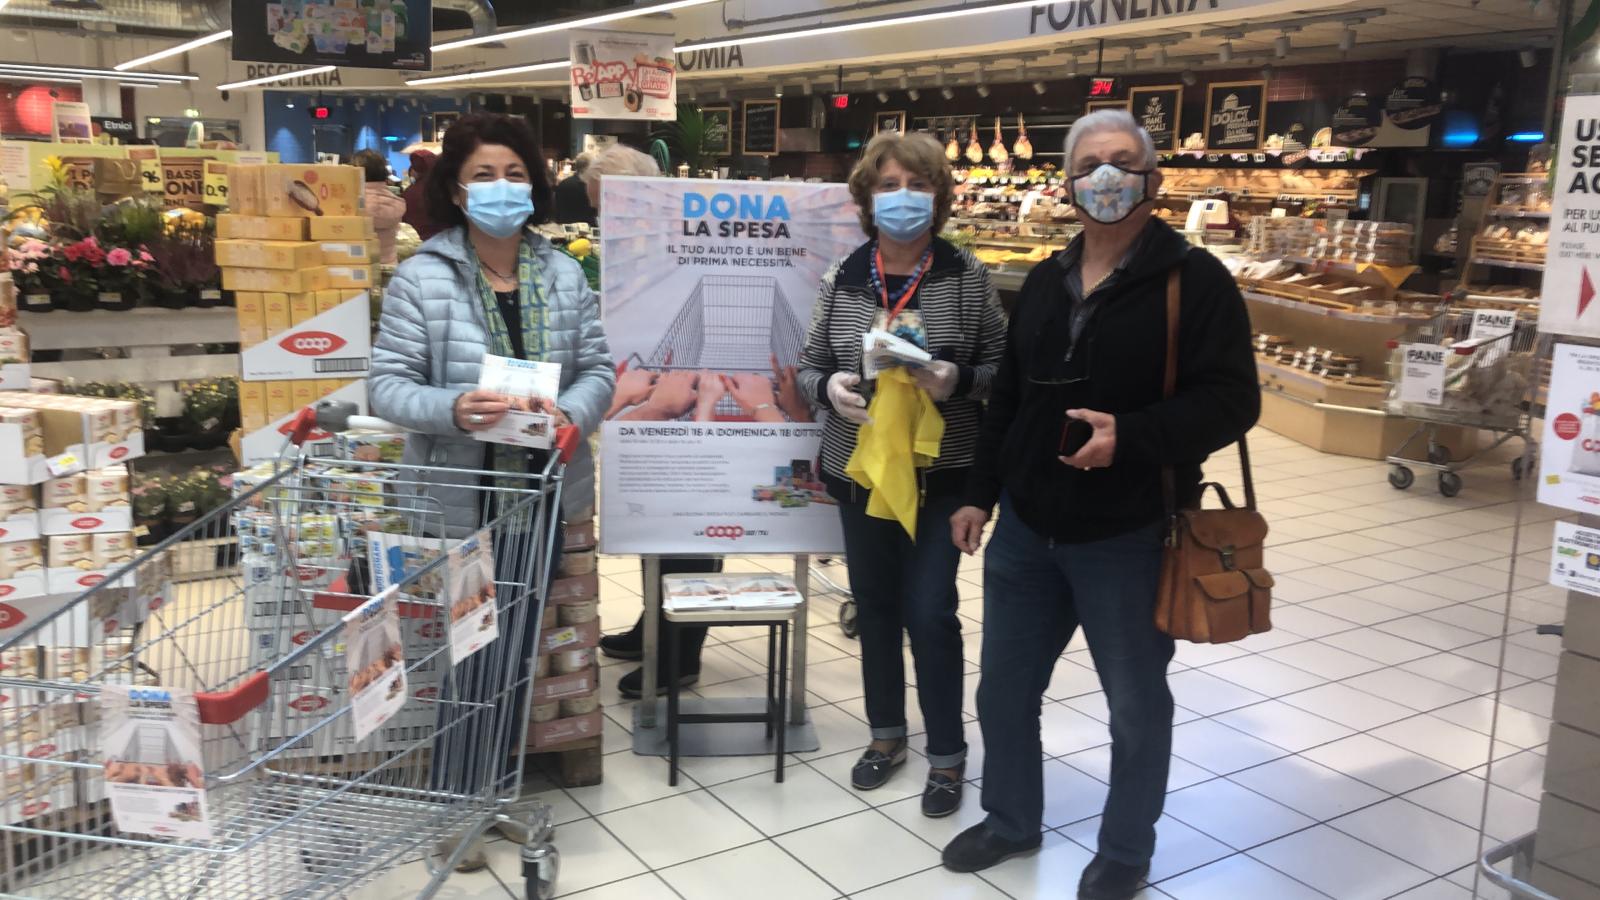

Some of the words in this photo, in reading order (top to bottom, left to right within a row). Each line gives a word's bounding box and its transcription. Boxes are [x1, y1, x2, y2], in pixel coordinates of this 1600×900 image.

[675, 39, 744, 71] OMIA
[1091, 80, 1112, 95] 34
[1211, 110, 1249, 126] DOLCI
[1576, 118, 1600, 142] U
[683, 192, 792, 221] DONA
[683, 220, 712, 237] LA
[718, 221, 792, 239] SPESA
[666, 245, 678, 254] IL
[681, 245, 705, 254] TUO
[709, 245, 744, 255] AIUTO
[757, 246, 775, 256] UN
[777, 247, 808, 257] BENE
[678, 256, 690, 265] DI
[693, 256, 729, 267] PRIMA
[619, 427, 637, 436] DA
[706, 428, 715, 437] A
[717, 427, 778, 438] DOMENICA
